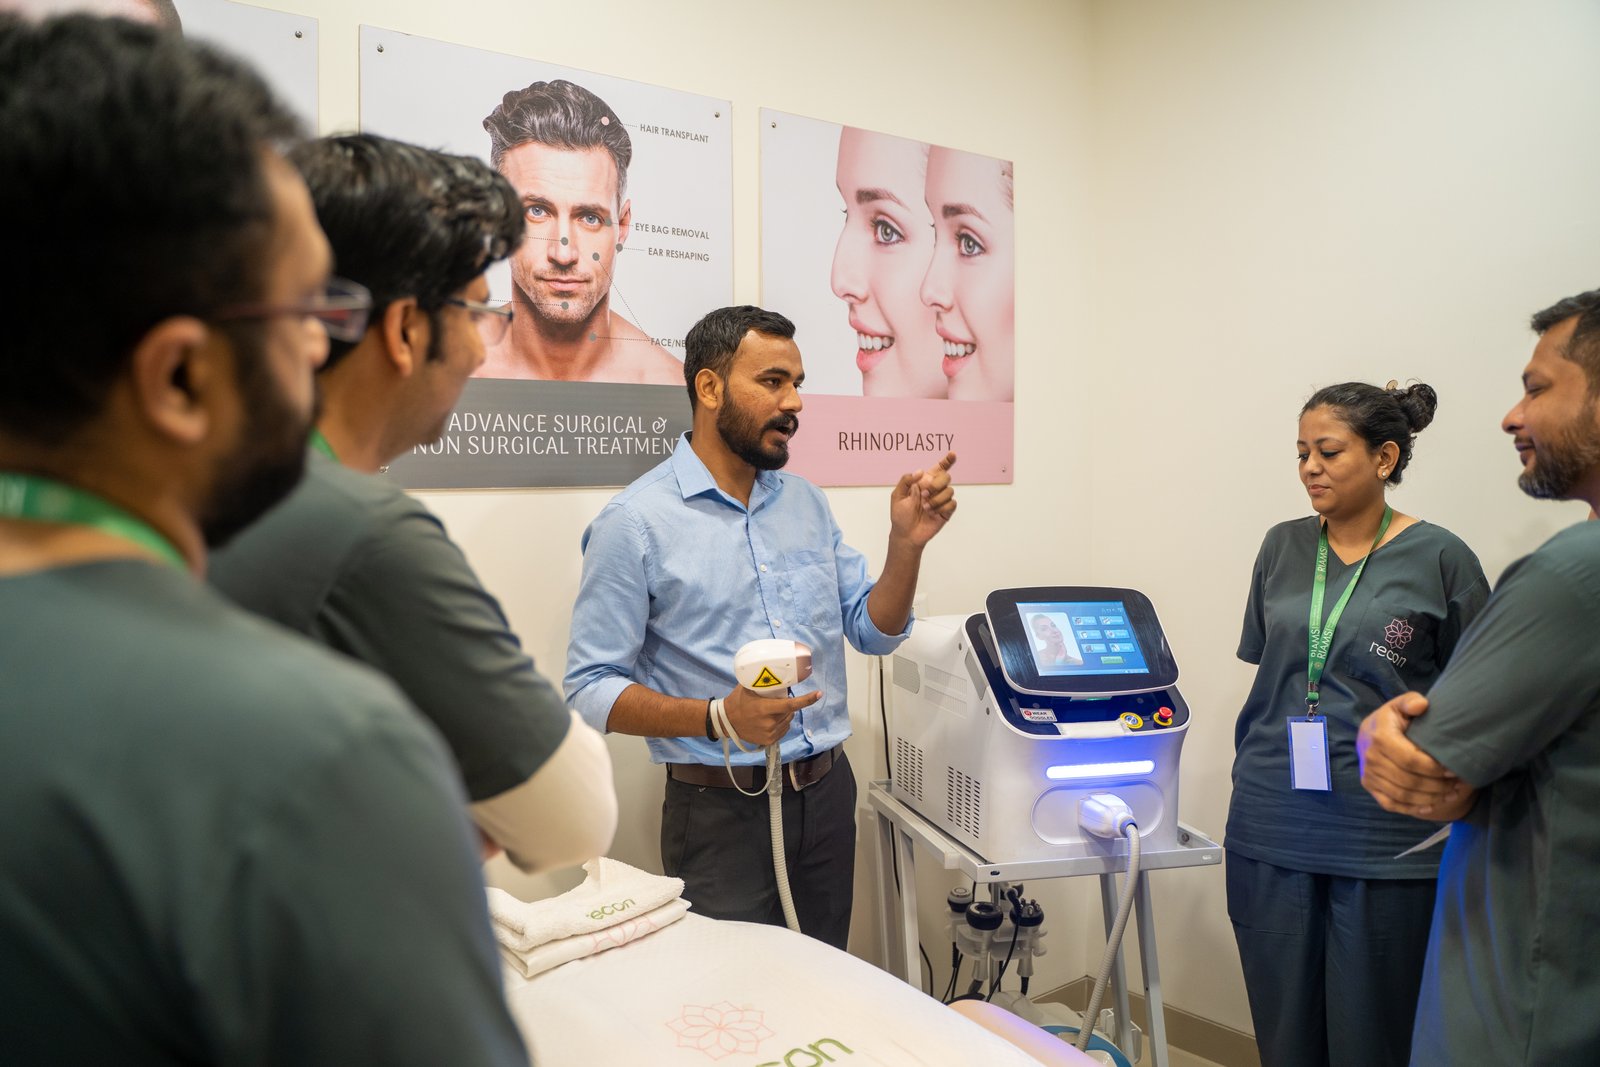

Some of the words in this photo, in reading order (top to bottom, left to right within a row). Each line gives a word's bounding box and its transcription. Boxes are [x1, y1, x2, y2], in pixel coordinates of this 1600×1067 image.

[640, 124, 659, 135] HAIR
[661, 127, 709, 143] TRANSPLANT
[635, 222, 650, 232] EYE
[651, 224, 669, 235] BAG
[671, 228, 710, 240] REMOVAL
[648, 247, 664, 257] EAR
[665, 249, 710, 262] RESHAPING
[448, 412, 547, 433] ADVANCE
[553, 414, 647, 434] SURGICAL
[467, 435, 569, 455] SURGICAL
[838, 431, 954, 452] RHINOPLASTY
[1369, 641, 1407, 668] recon
